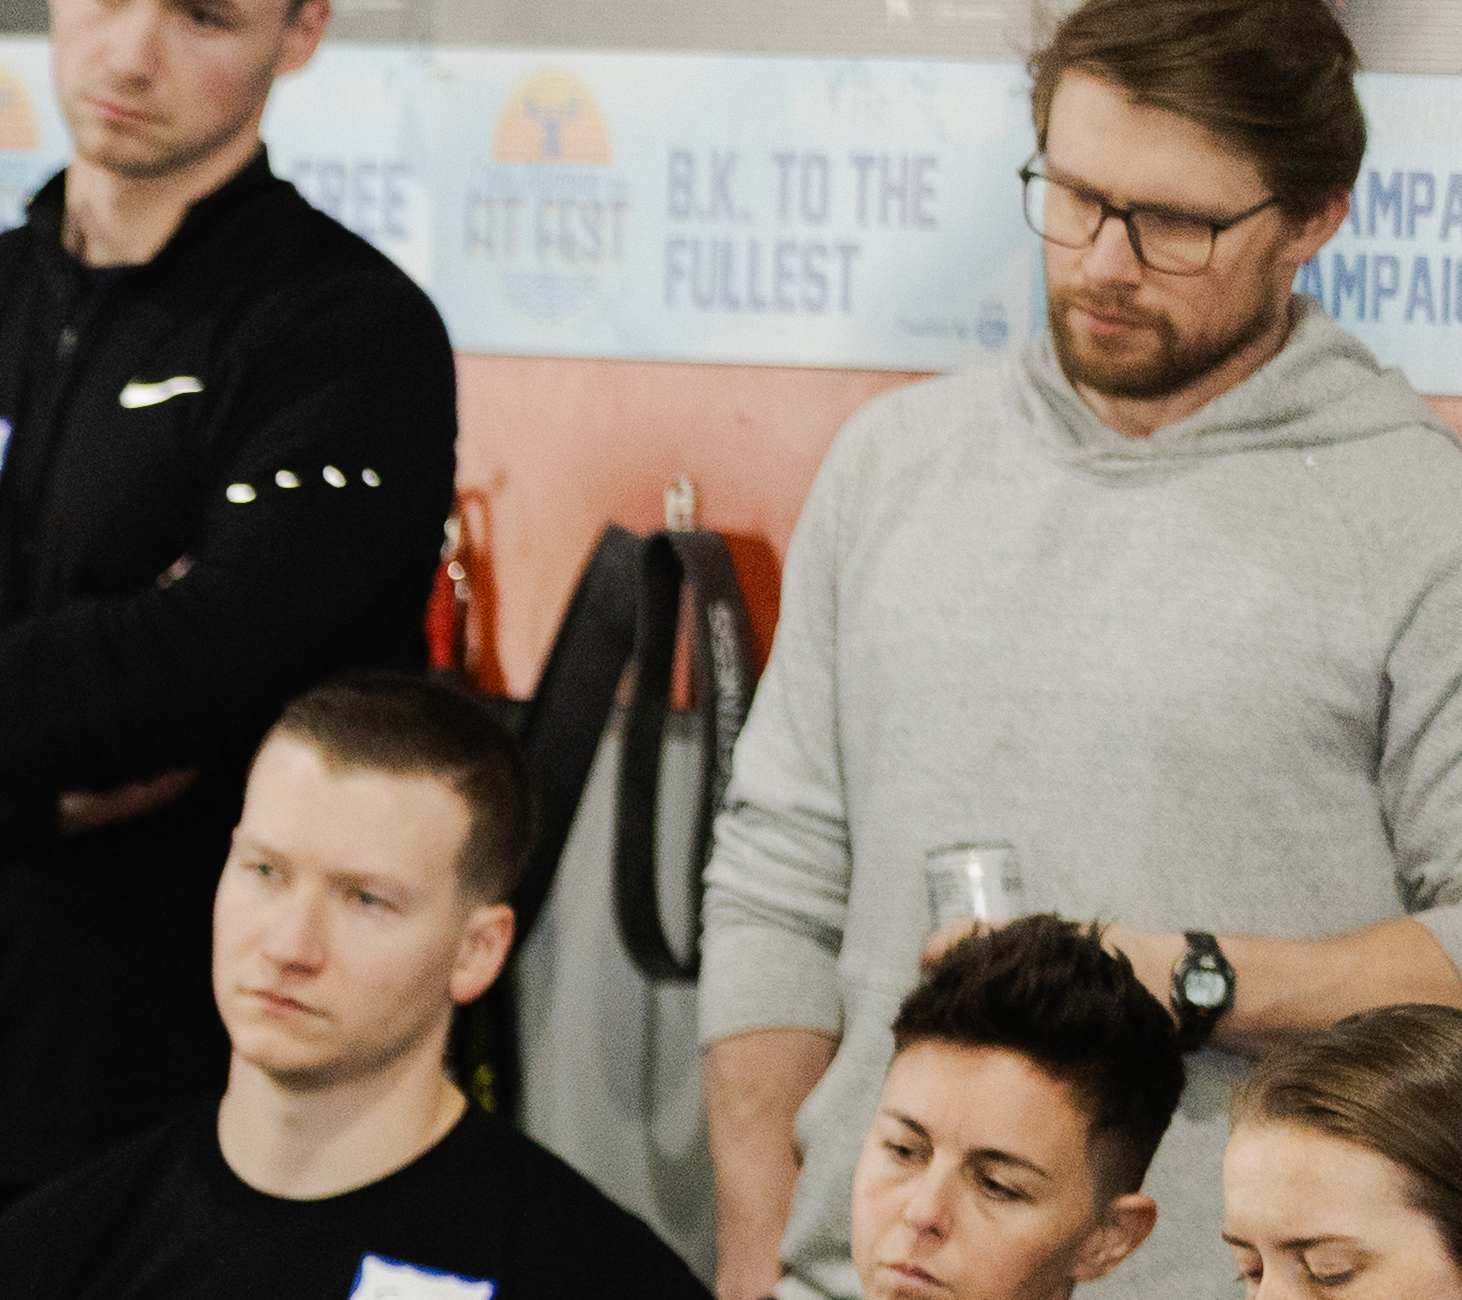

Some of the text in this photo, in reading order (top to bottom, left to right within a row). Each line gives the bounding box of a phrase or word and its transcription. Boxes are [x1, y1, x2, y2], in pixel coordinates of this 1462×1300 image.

[667, 149, 938, 230] B.K. TO THE
[665, 236, 862, 316] FULLEST
